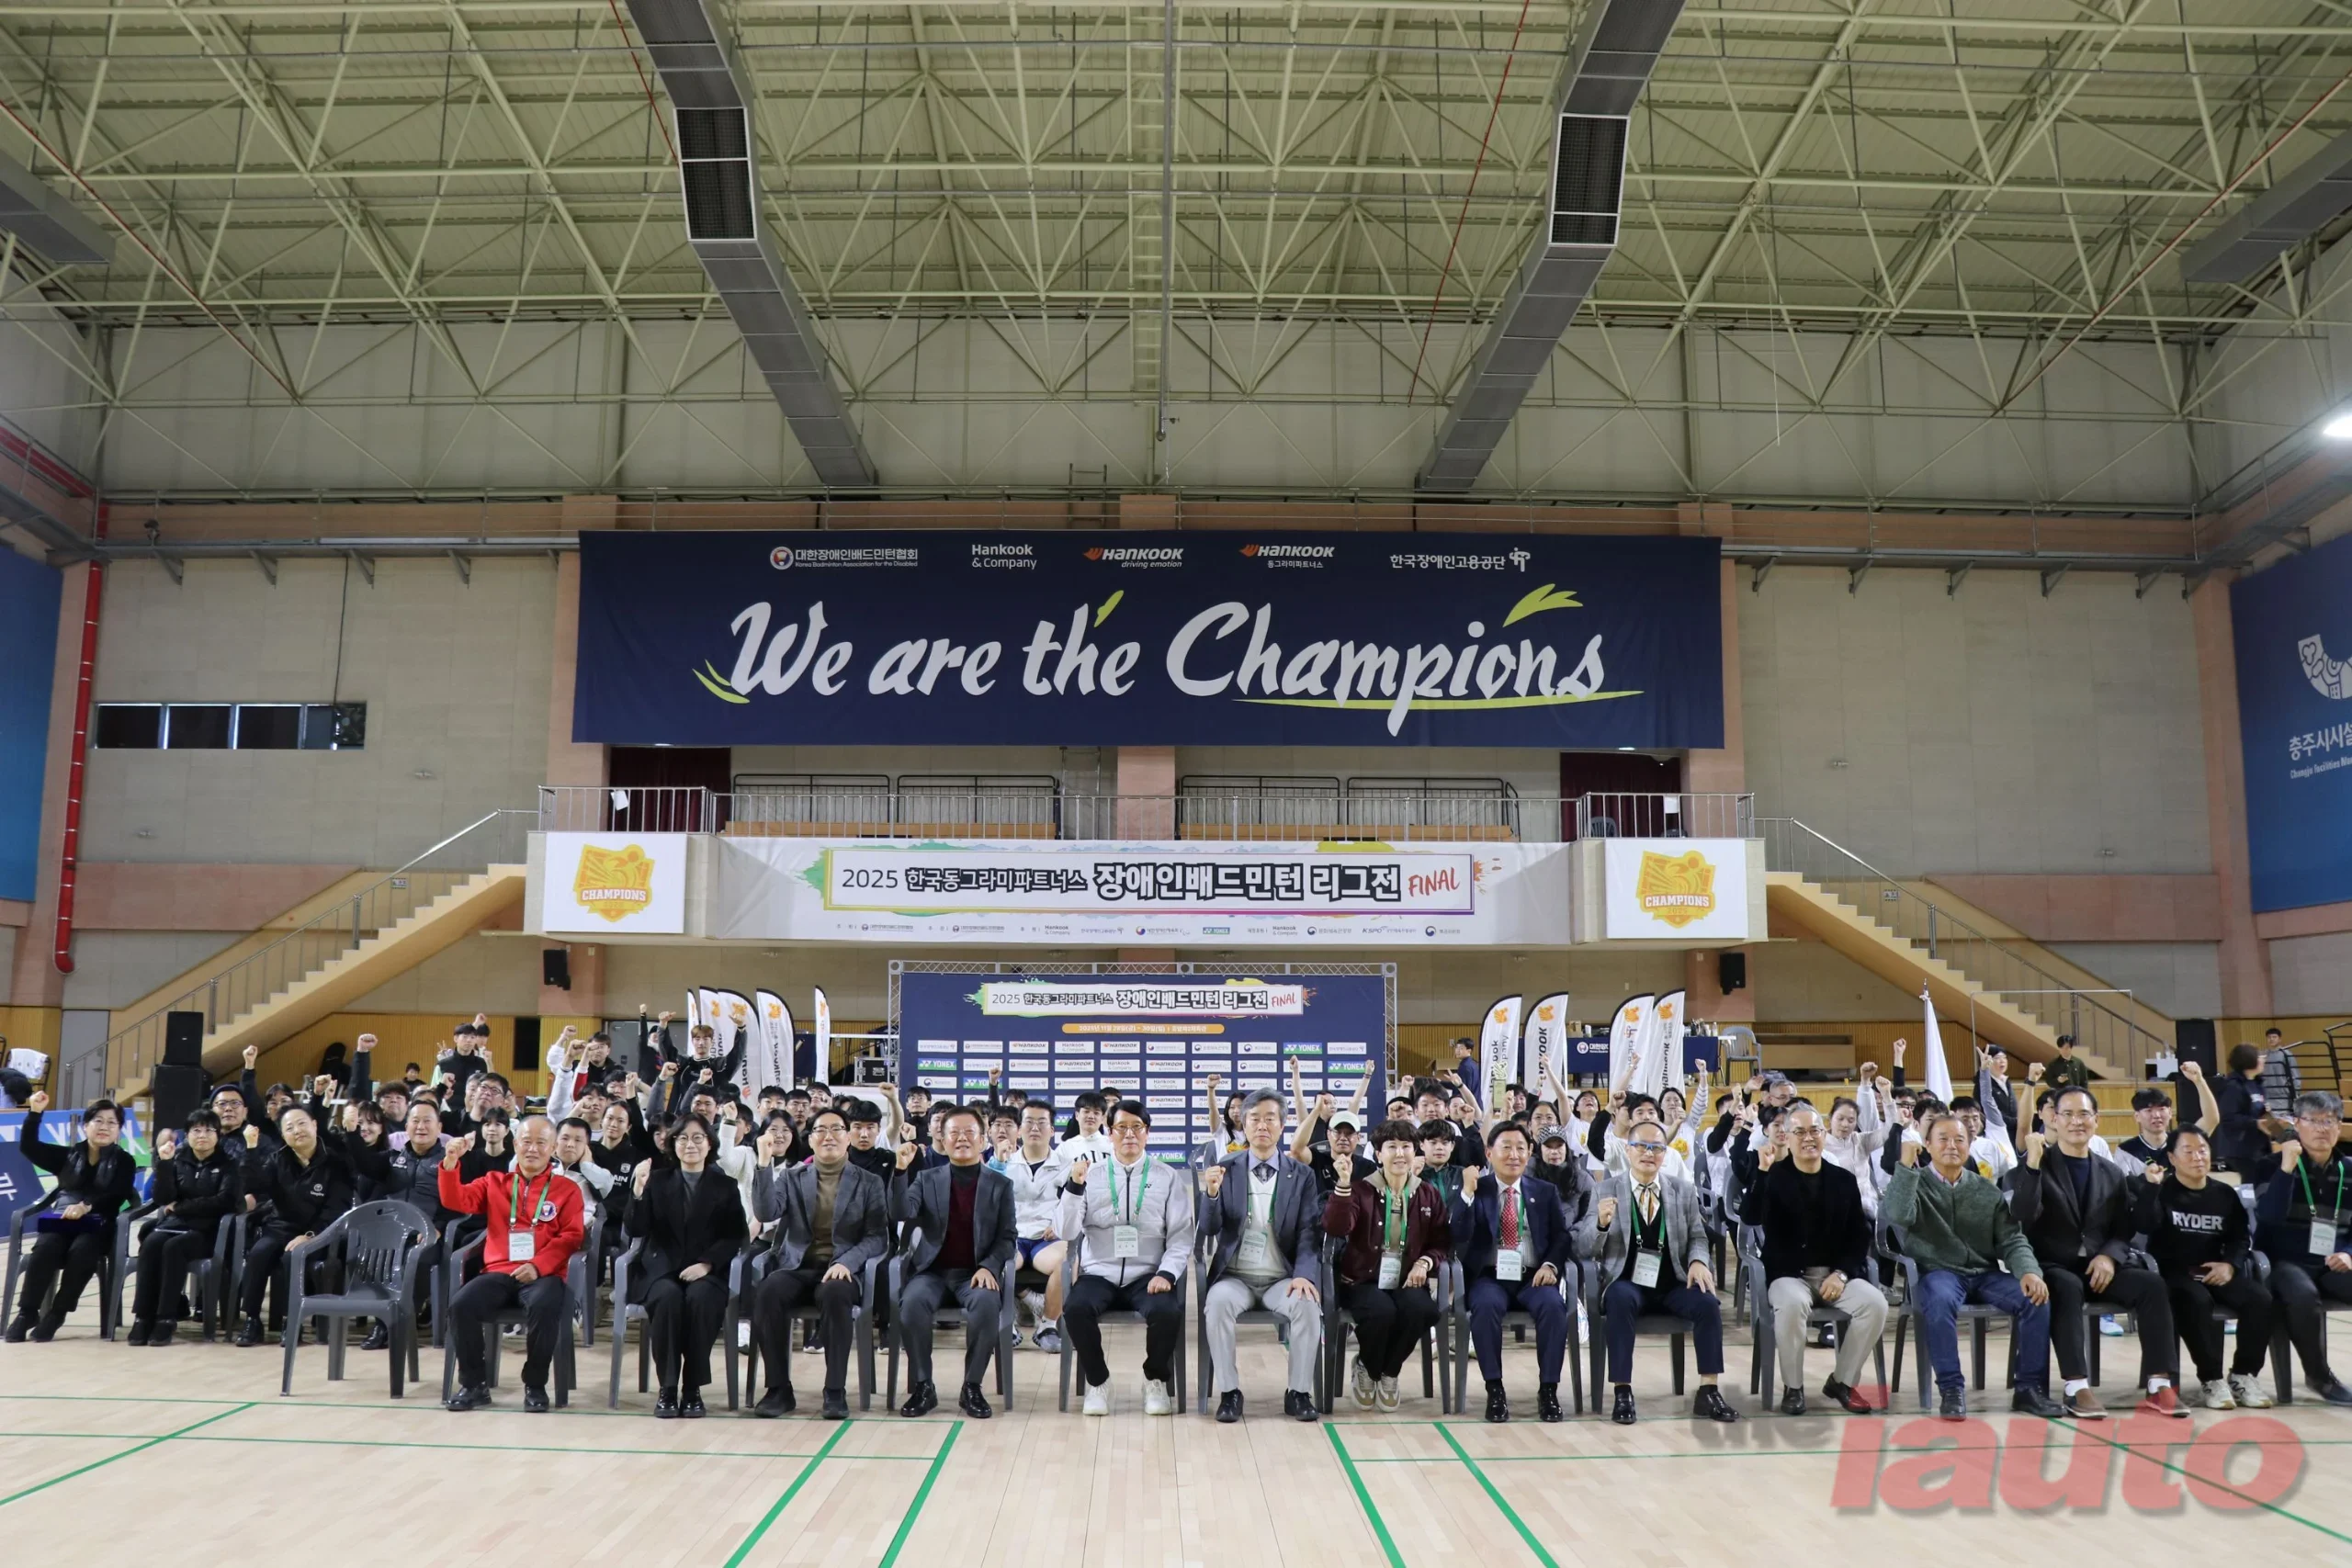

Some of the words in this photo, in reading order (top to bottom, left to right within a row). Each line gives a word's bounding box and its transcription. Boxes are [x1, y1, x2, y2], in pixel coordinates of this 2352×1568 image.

[795, 548, 918, 560] 대한장애인배드민턴협회
[971, 544, 1034, 556] Hankook
[971, 558, 982, 569] &
[983, 558, 1037, 570] Company
[1121, 560, 1148, 569] driving
[1267, 560, 1324, 569] 동그라미파트너스
[1389, 554, 1507, 570] 한국장애인고용공단
[729, 600, 854, 696] We
[867, 637, 1002, 696] are
[1021, 602, 1141, 696] the
[1165, 601, 1606, 738] Champions
[842, 868, 899, 889] 2025
[905, 866, 1088, 893] 한국동그라미파트너스
[1093, 862, 1305, 901] 장애인배드민턴
[1309, 863, 1402, 902] 리그전
[1407, 866, 1461, 897] FINAL
[582, 888, 647, 902] CHAMPIONS
[1645, 895, 1710, 908] CHAMPIONS
[991, 994, 1021, 1004] 2025
[1116, 989, 1221, 1010] 장애인배드민턴
[1222, 990, 1269, 1010] 리그전
[1271, 992, 1297, 1008] FINAL
[1298, 1043, 1320, 1052] YONEX
[933, 1059, 956, 1068] YONEX
[1342, 1063, 1365, 1071] YONEX
[1160, 1151, 1184, 1160] YONEX
[2171, 1210, 2223, 1231] RYDER
